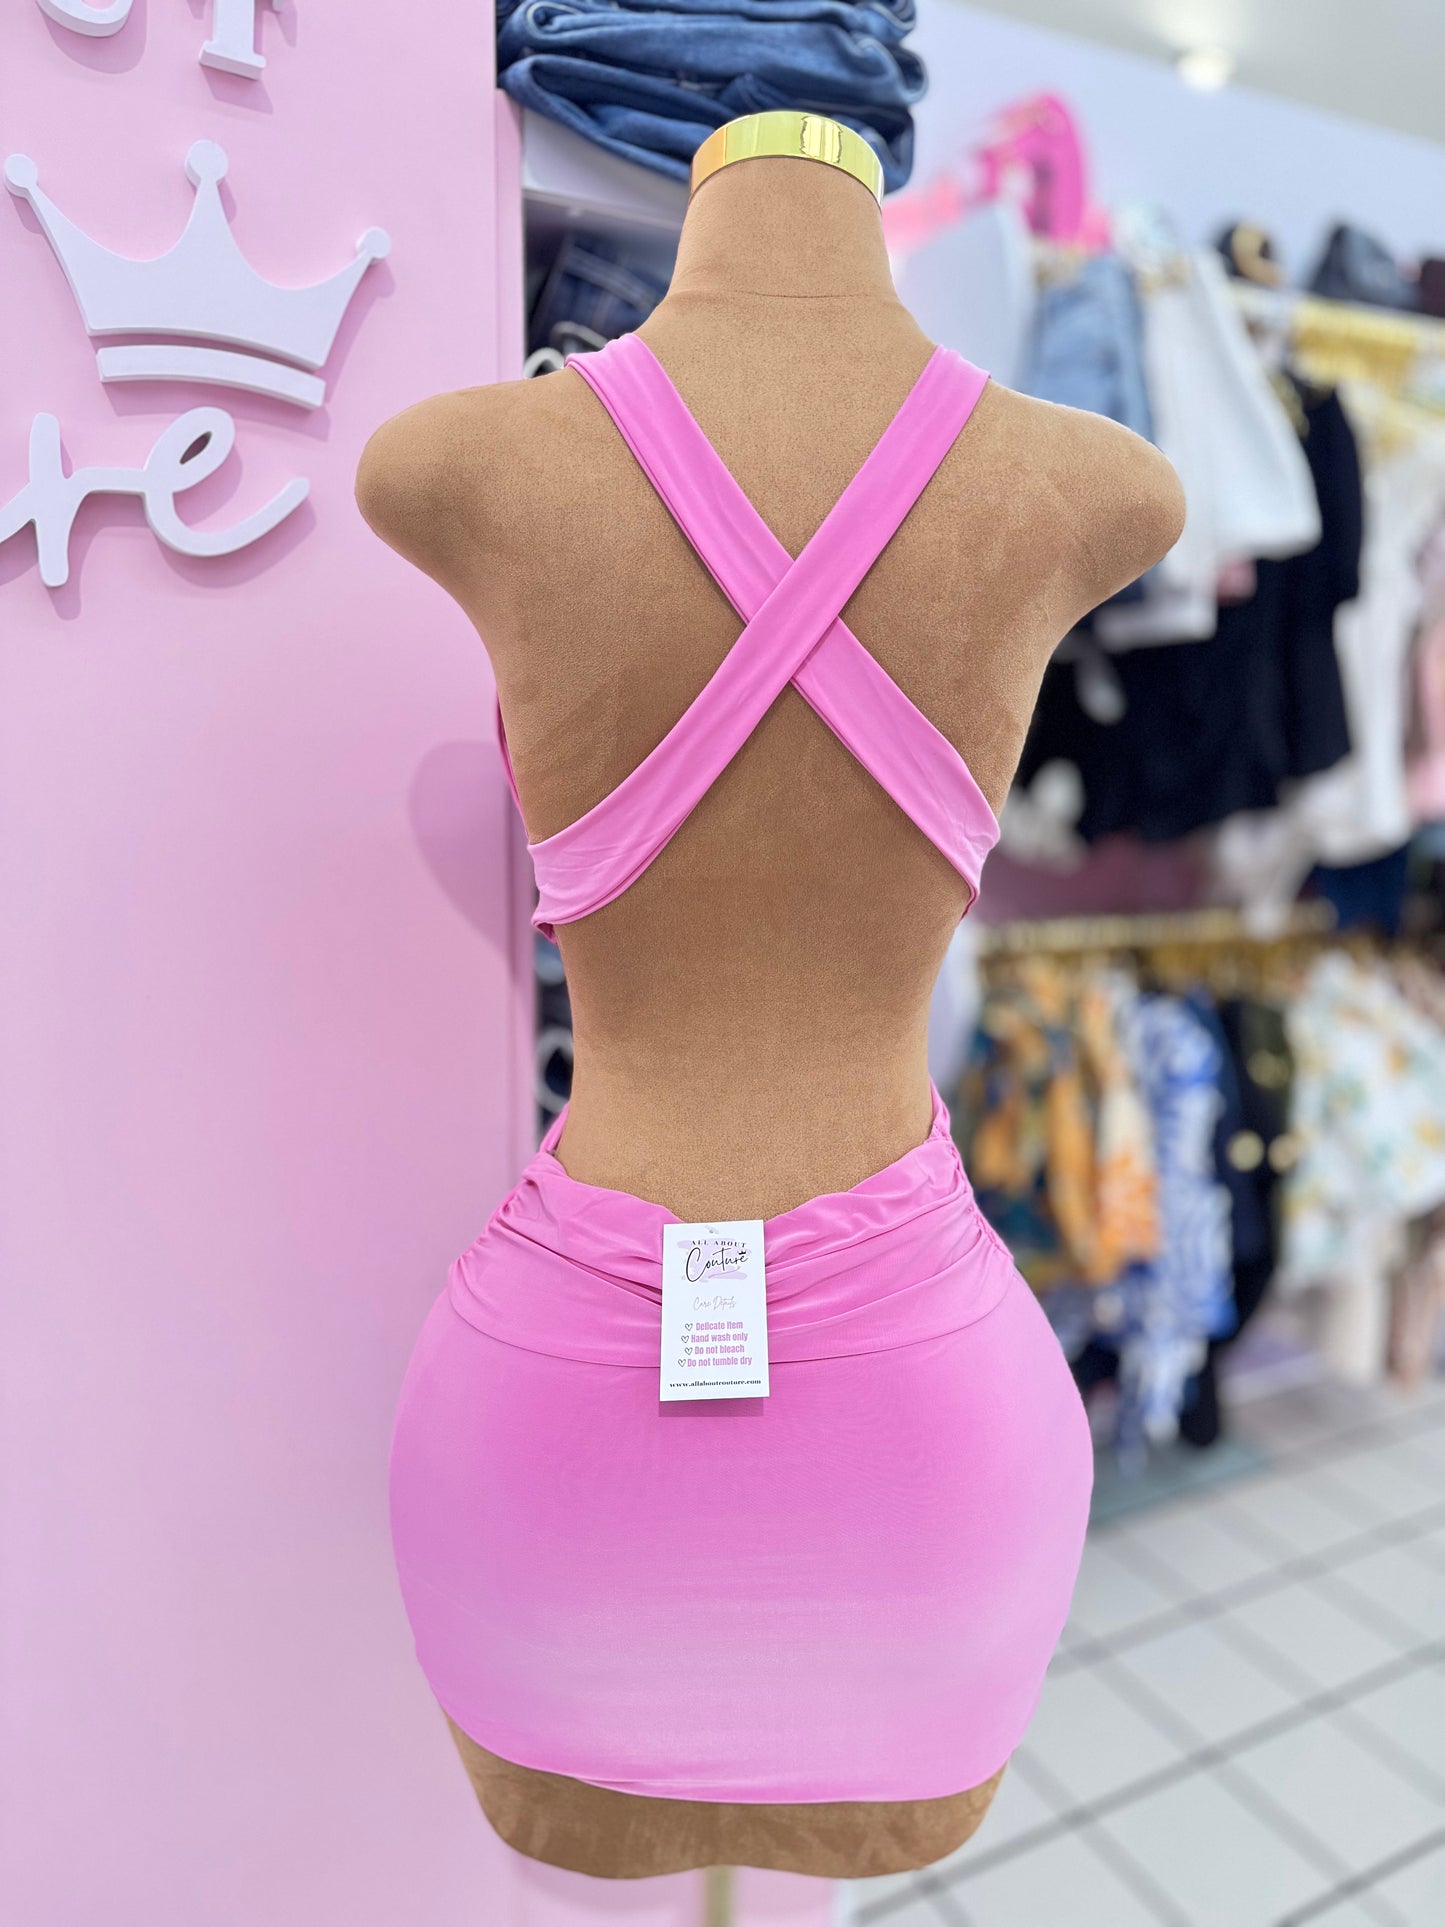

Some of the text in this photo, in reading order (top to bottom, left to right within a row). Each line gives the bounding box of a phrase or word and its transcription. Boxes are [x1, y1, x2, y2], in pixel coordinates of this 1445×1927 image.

[714, 1240, 747, 1248] ABOUT
[686, 1247, 749, 1282] Couture
[695, 1321, 743, 1331] Delicate Item
[691, 1332, 748, 1343] Hand wash only
[694, 1344, 745, 1355] Do not bleach
[687, 1356, 752, 1367] Do not tumble dry
[669, 1380, 762, 1388] www.allaboutcouture.com
